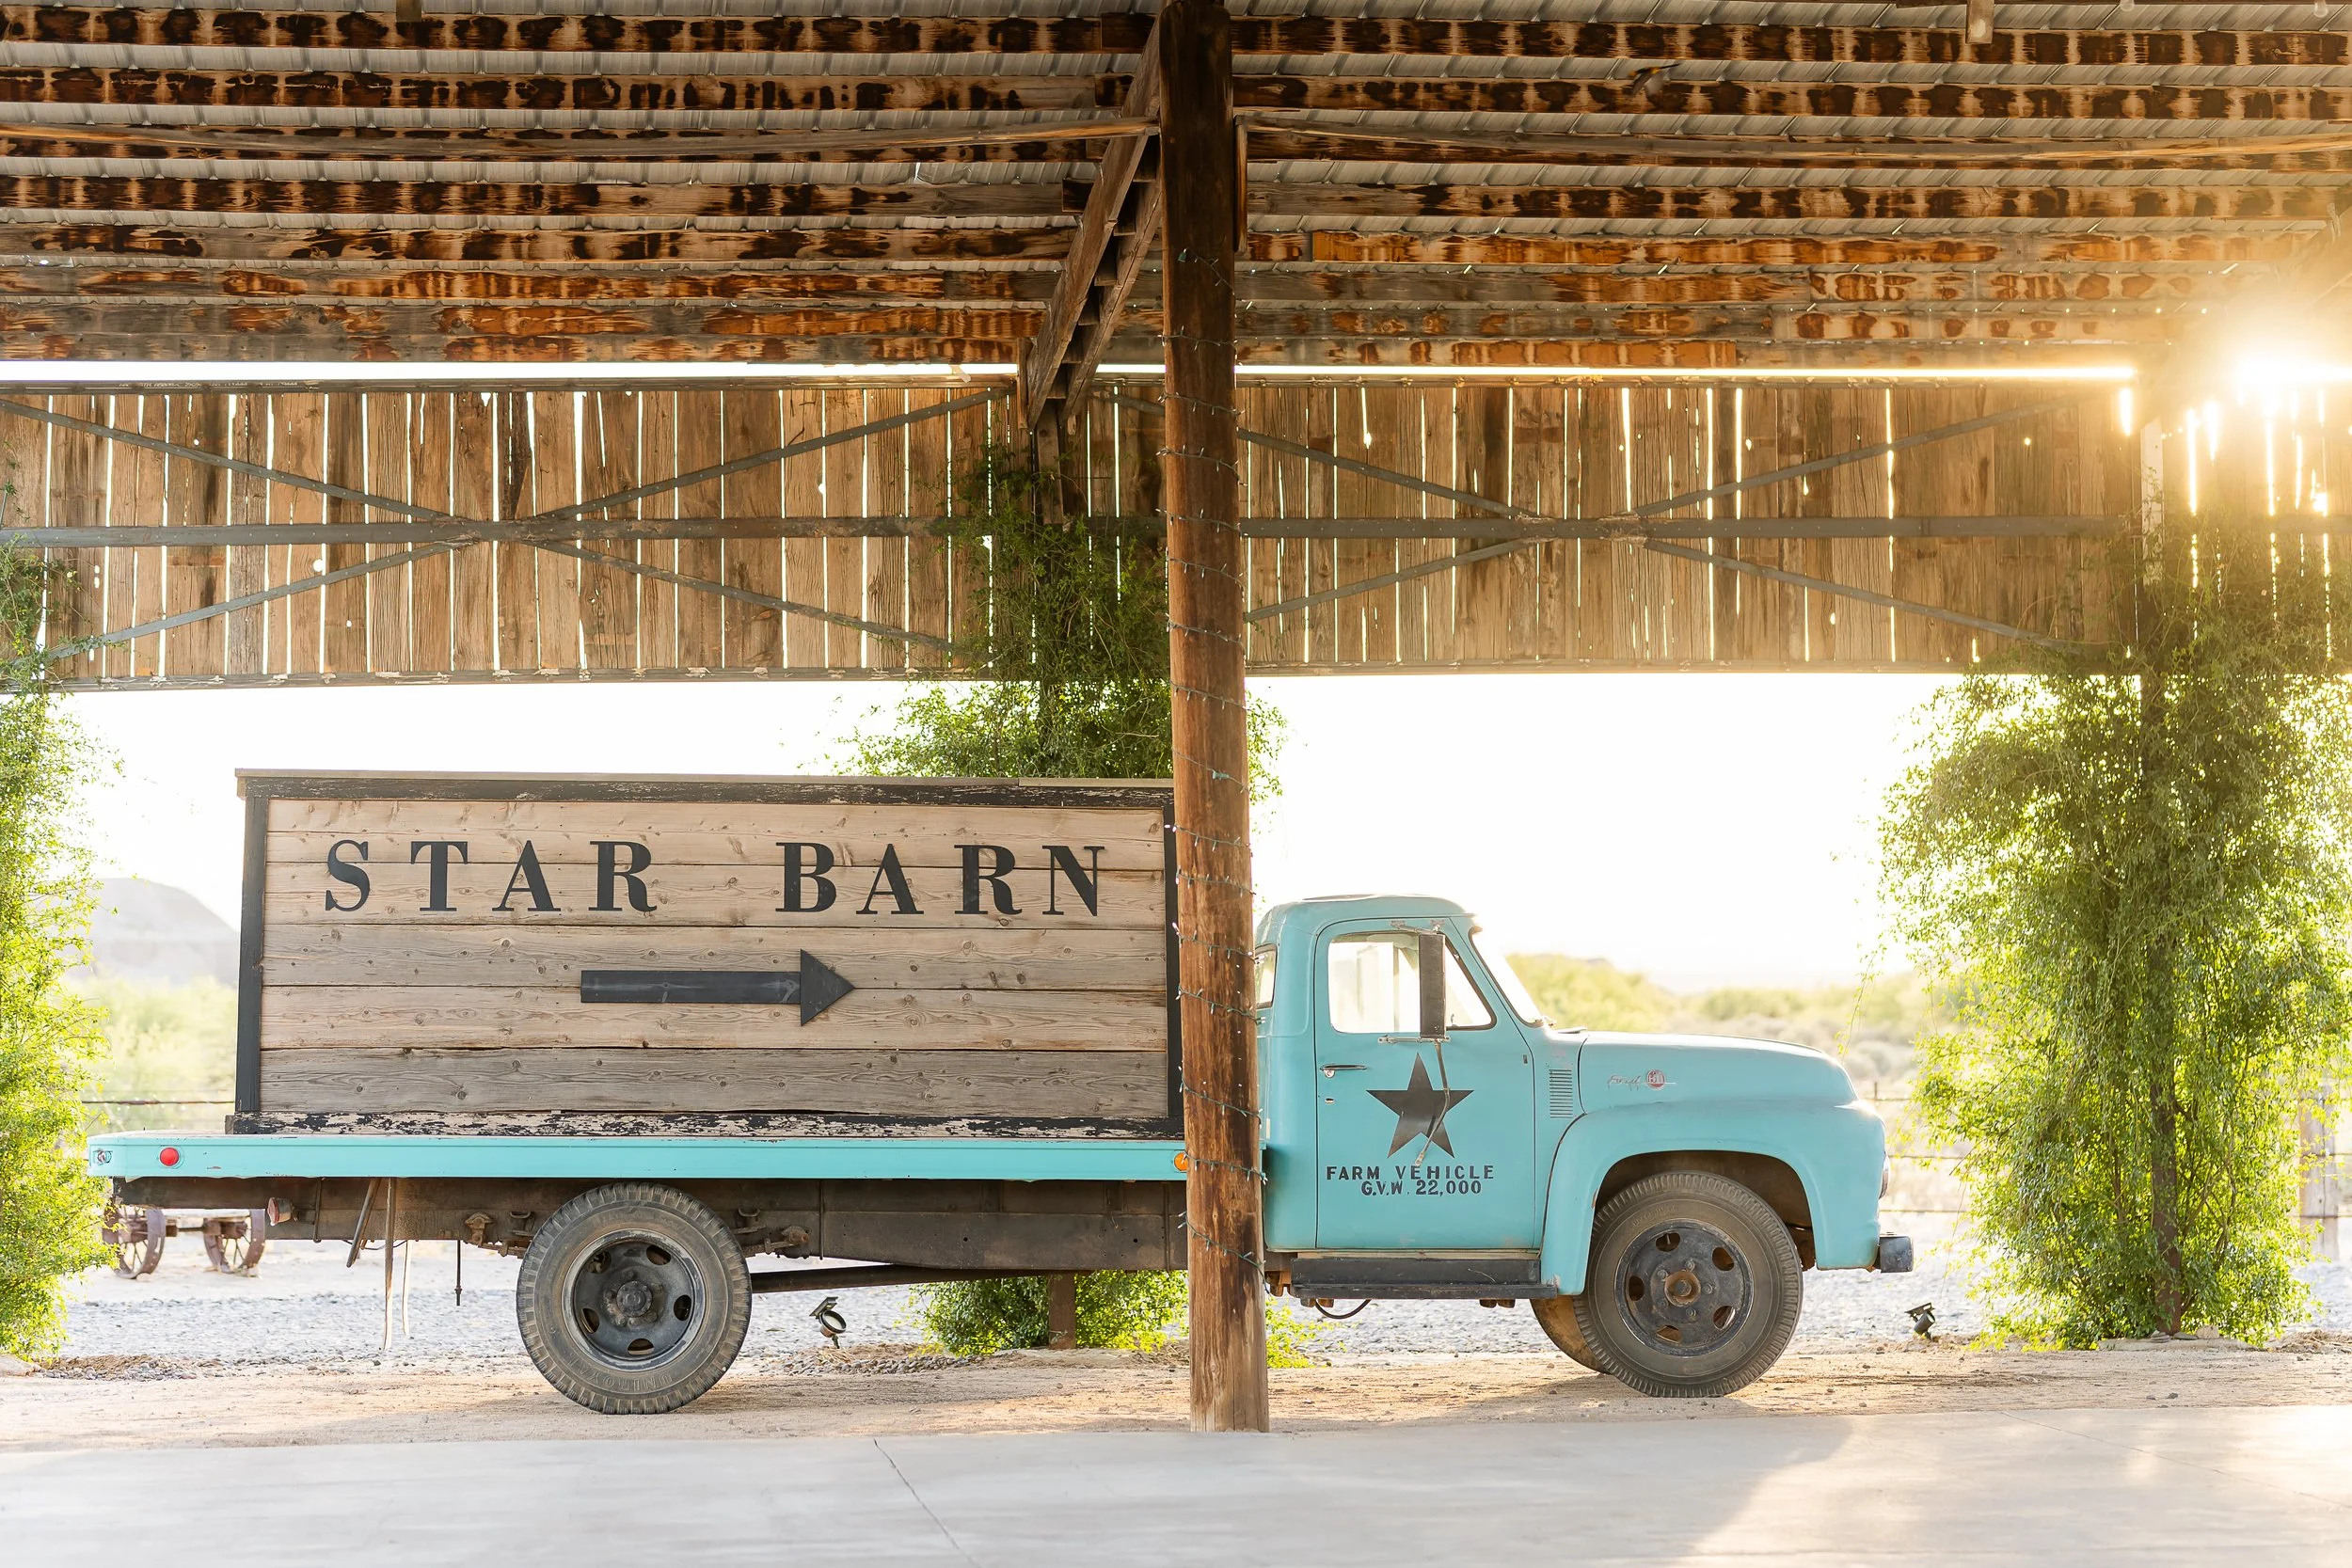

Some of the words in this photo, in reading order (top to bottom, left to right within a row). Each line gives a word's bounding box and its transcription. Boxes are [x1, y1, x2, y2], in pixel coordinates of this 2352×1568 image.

[325, 839, 659, 912] STAR
[775, 841, 1105, 917] BARN
[1326, 1165, 1380, 1180] FARM
[1395, 1164, 1494, 1180] VEHICLE
[1415, 1179, 1482, 1197] 22,000
[566, 1354, 674, 1392] UNIROYAL
